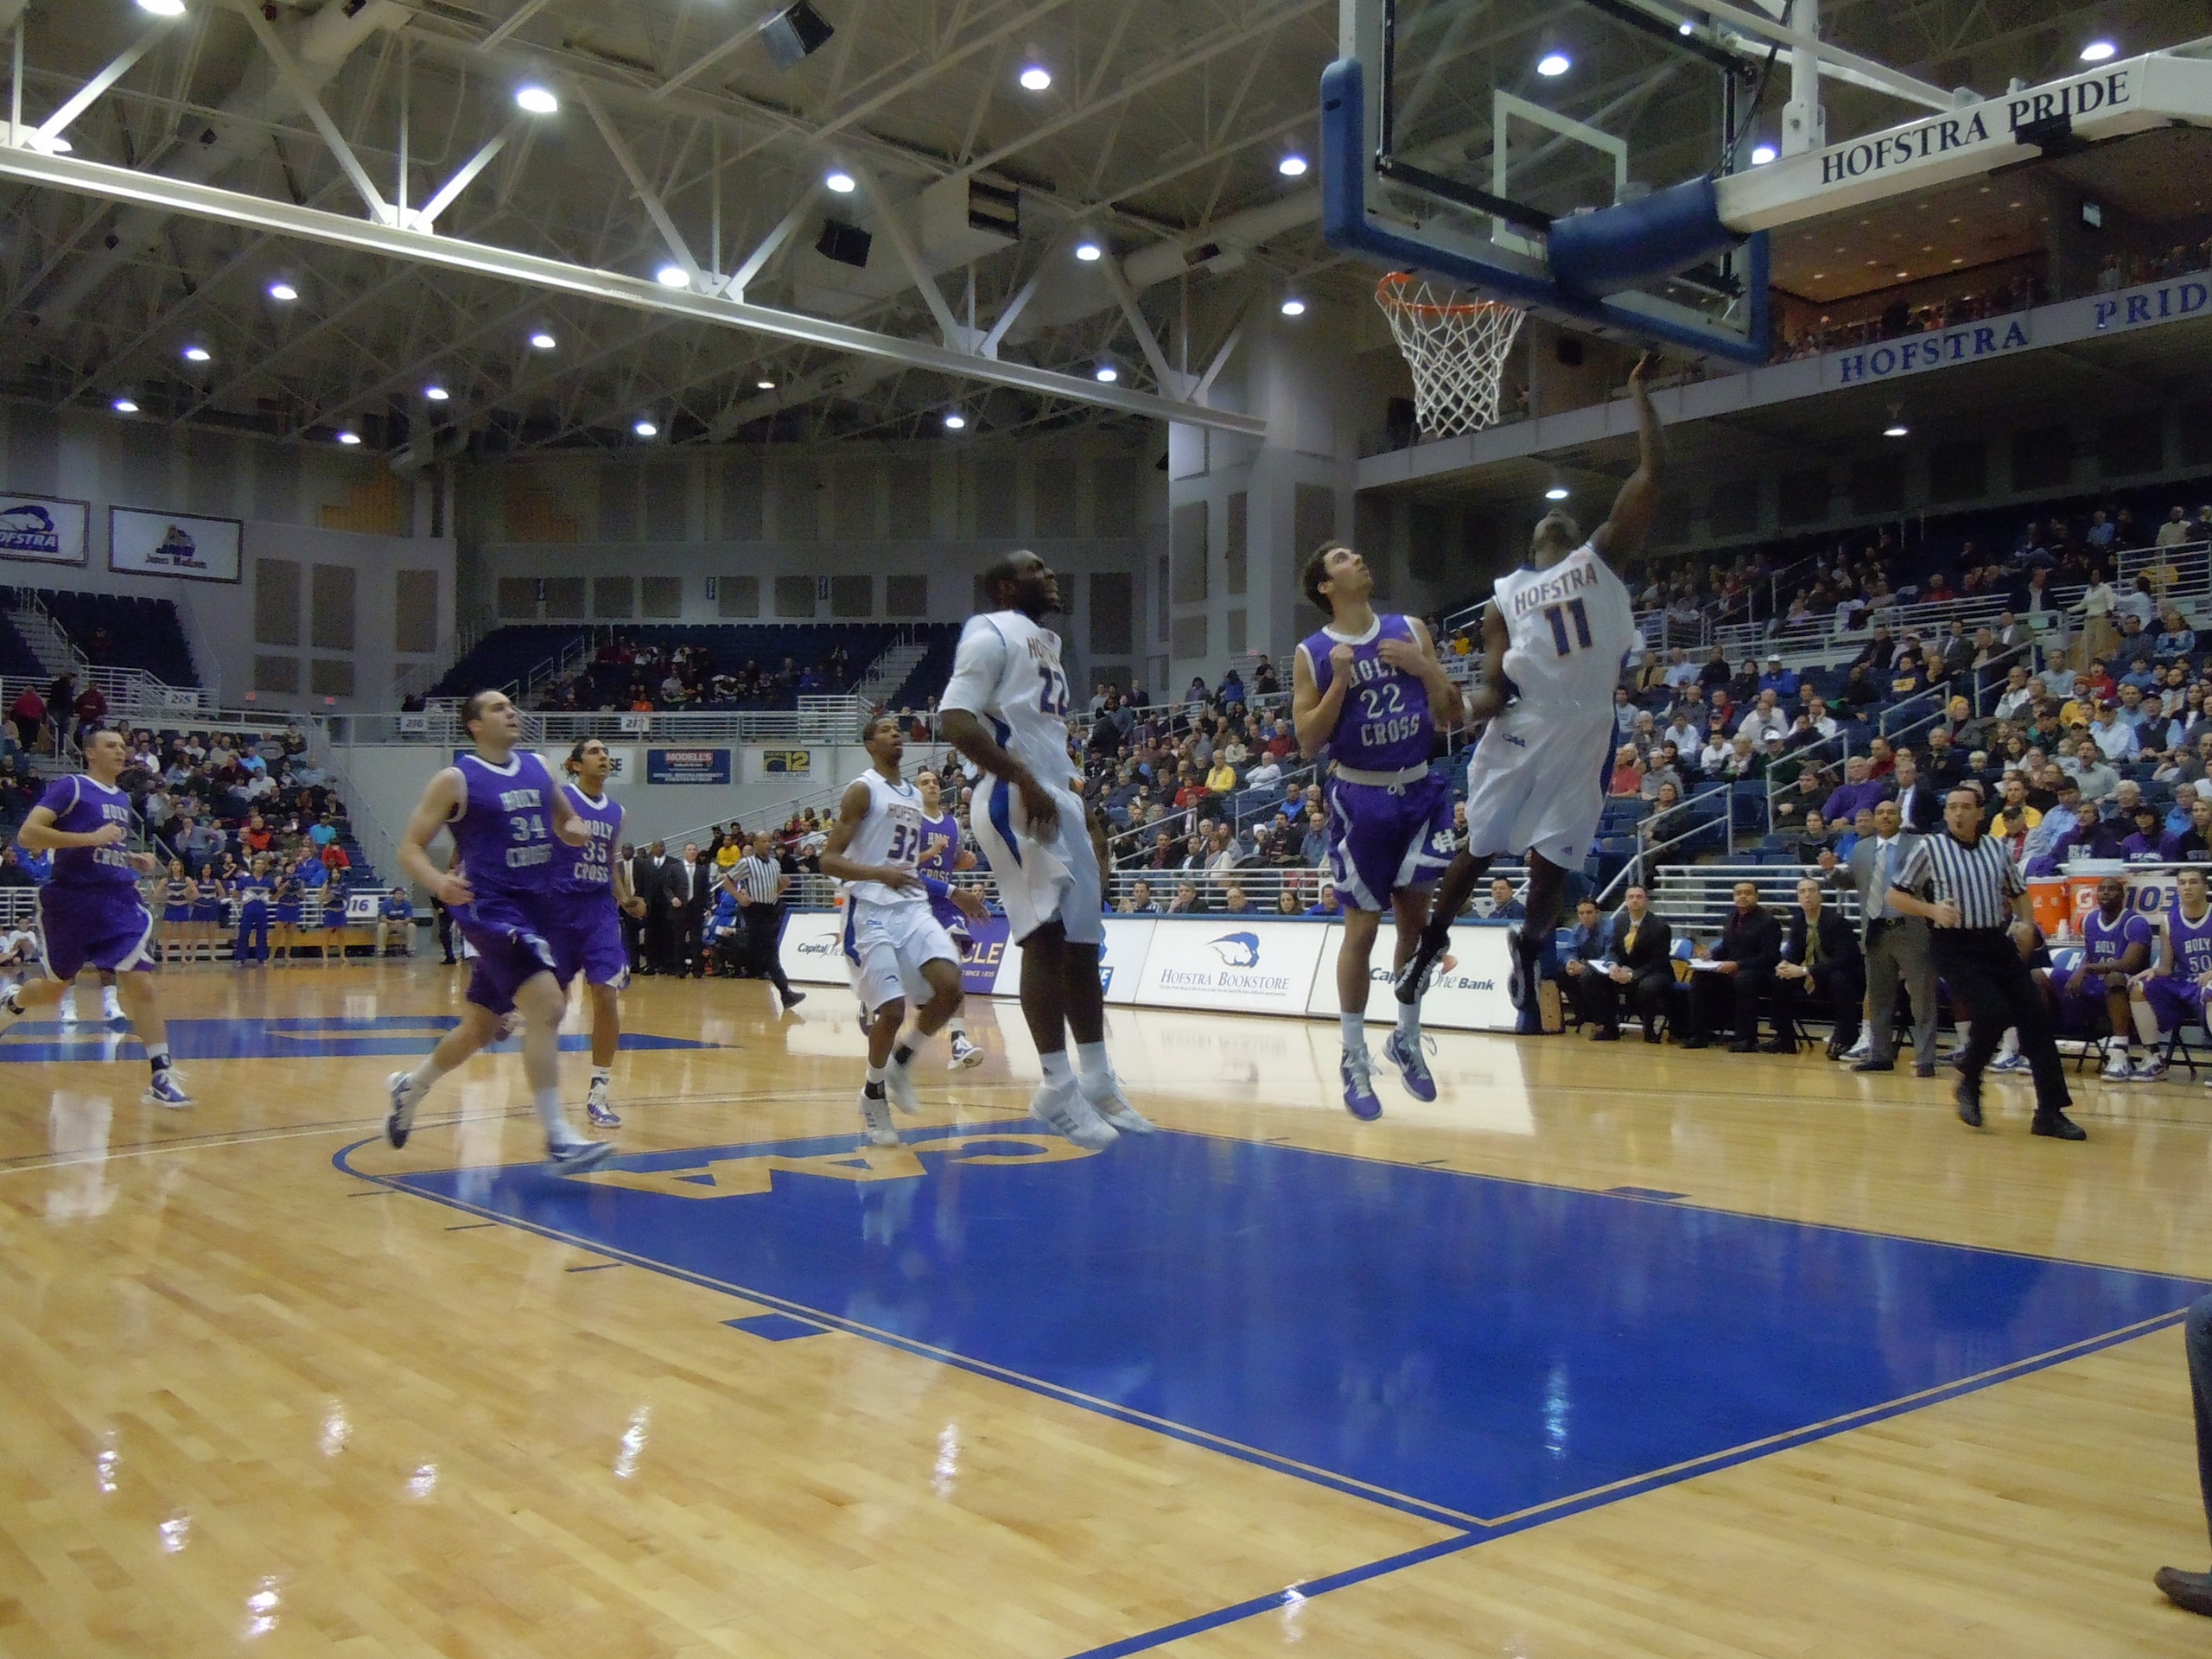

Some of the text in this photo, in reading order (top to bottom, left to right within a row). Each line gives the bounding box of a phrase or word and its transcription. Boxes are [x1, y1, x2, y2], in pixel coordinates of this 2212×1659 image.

[1821, 71, 2131, 185] HOFSTRA PRIDE
[1840, 282, 2208, 383] HOFSTRA PRID
[0, 531, 57, 548] OFSTRA
[1514, 563, 1598, 616] HOFSTRA
[1543, 595, 1592, 658] 11
[1359, 683, 1405, 720] 22
[1361, 714, 1420, 747] CROSS
[666, 752, 713, 761] MODELL'S
[785, 751, 810, 772] 12
[510, 814, 548, 842] 34
[582, 840, 607, 862] 35
[887, 823, 918, 863] 32
[574, 861, 608, 883] CROSS
[798, 942, 827, 954] Capital
[2094, 940, 2116, 954] HOLY
[2184, 938, 2210, 954] HOLY
[1160, 969, 1290, 990] HOFSTRA BOOKSTORE
[1431, 969, 1496, 991] One Bank
